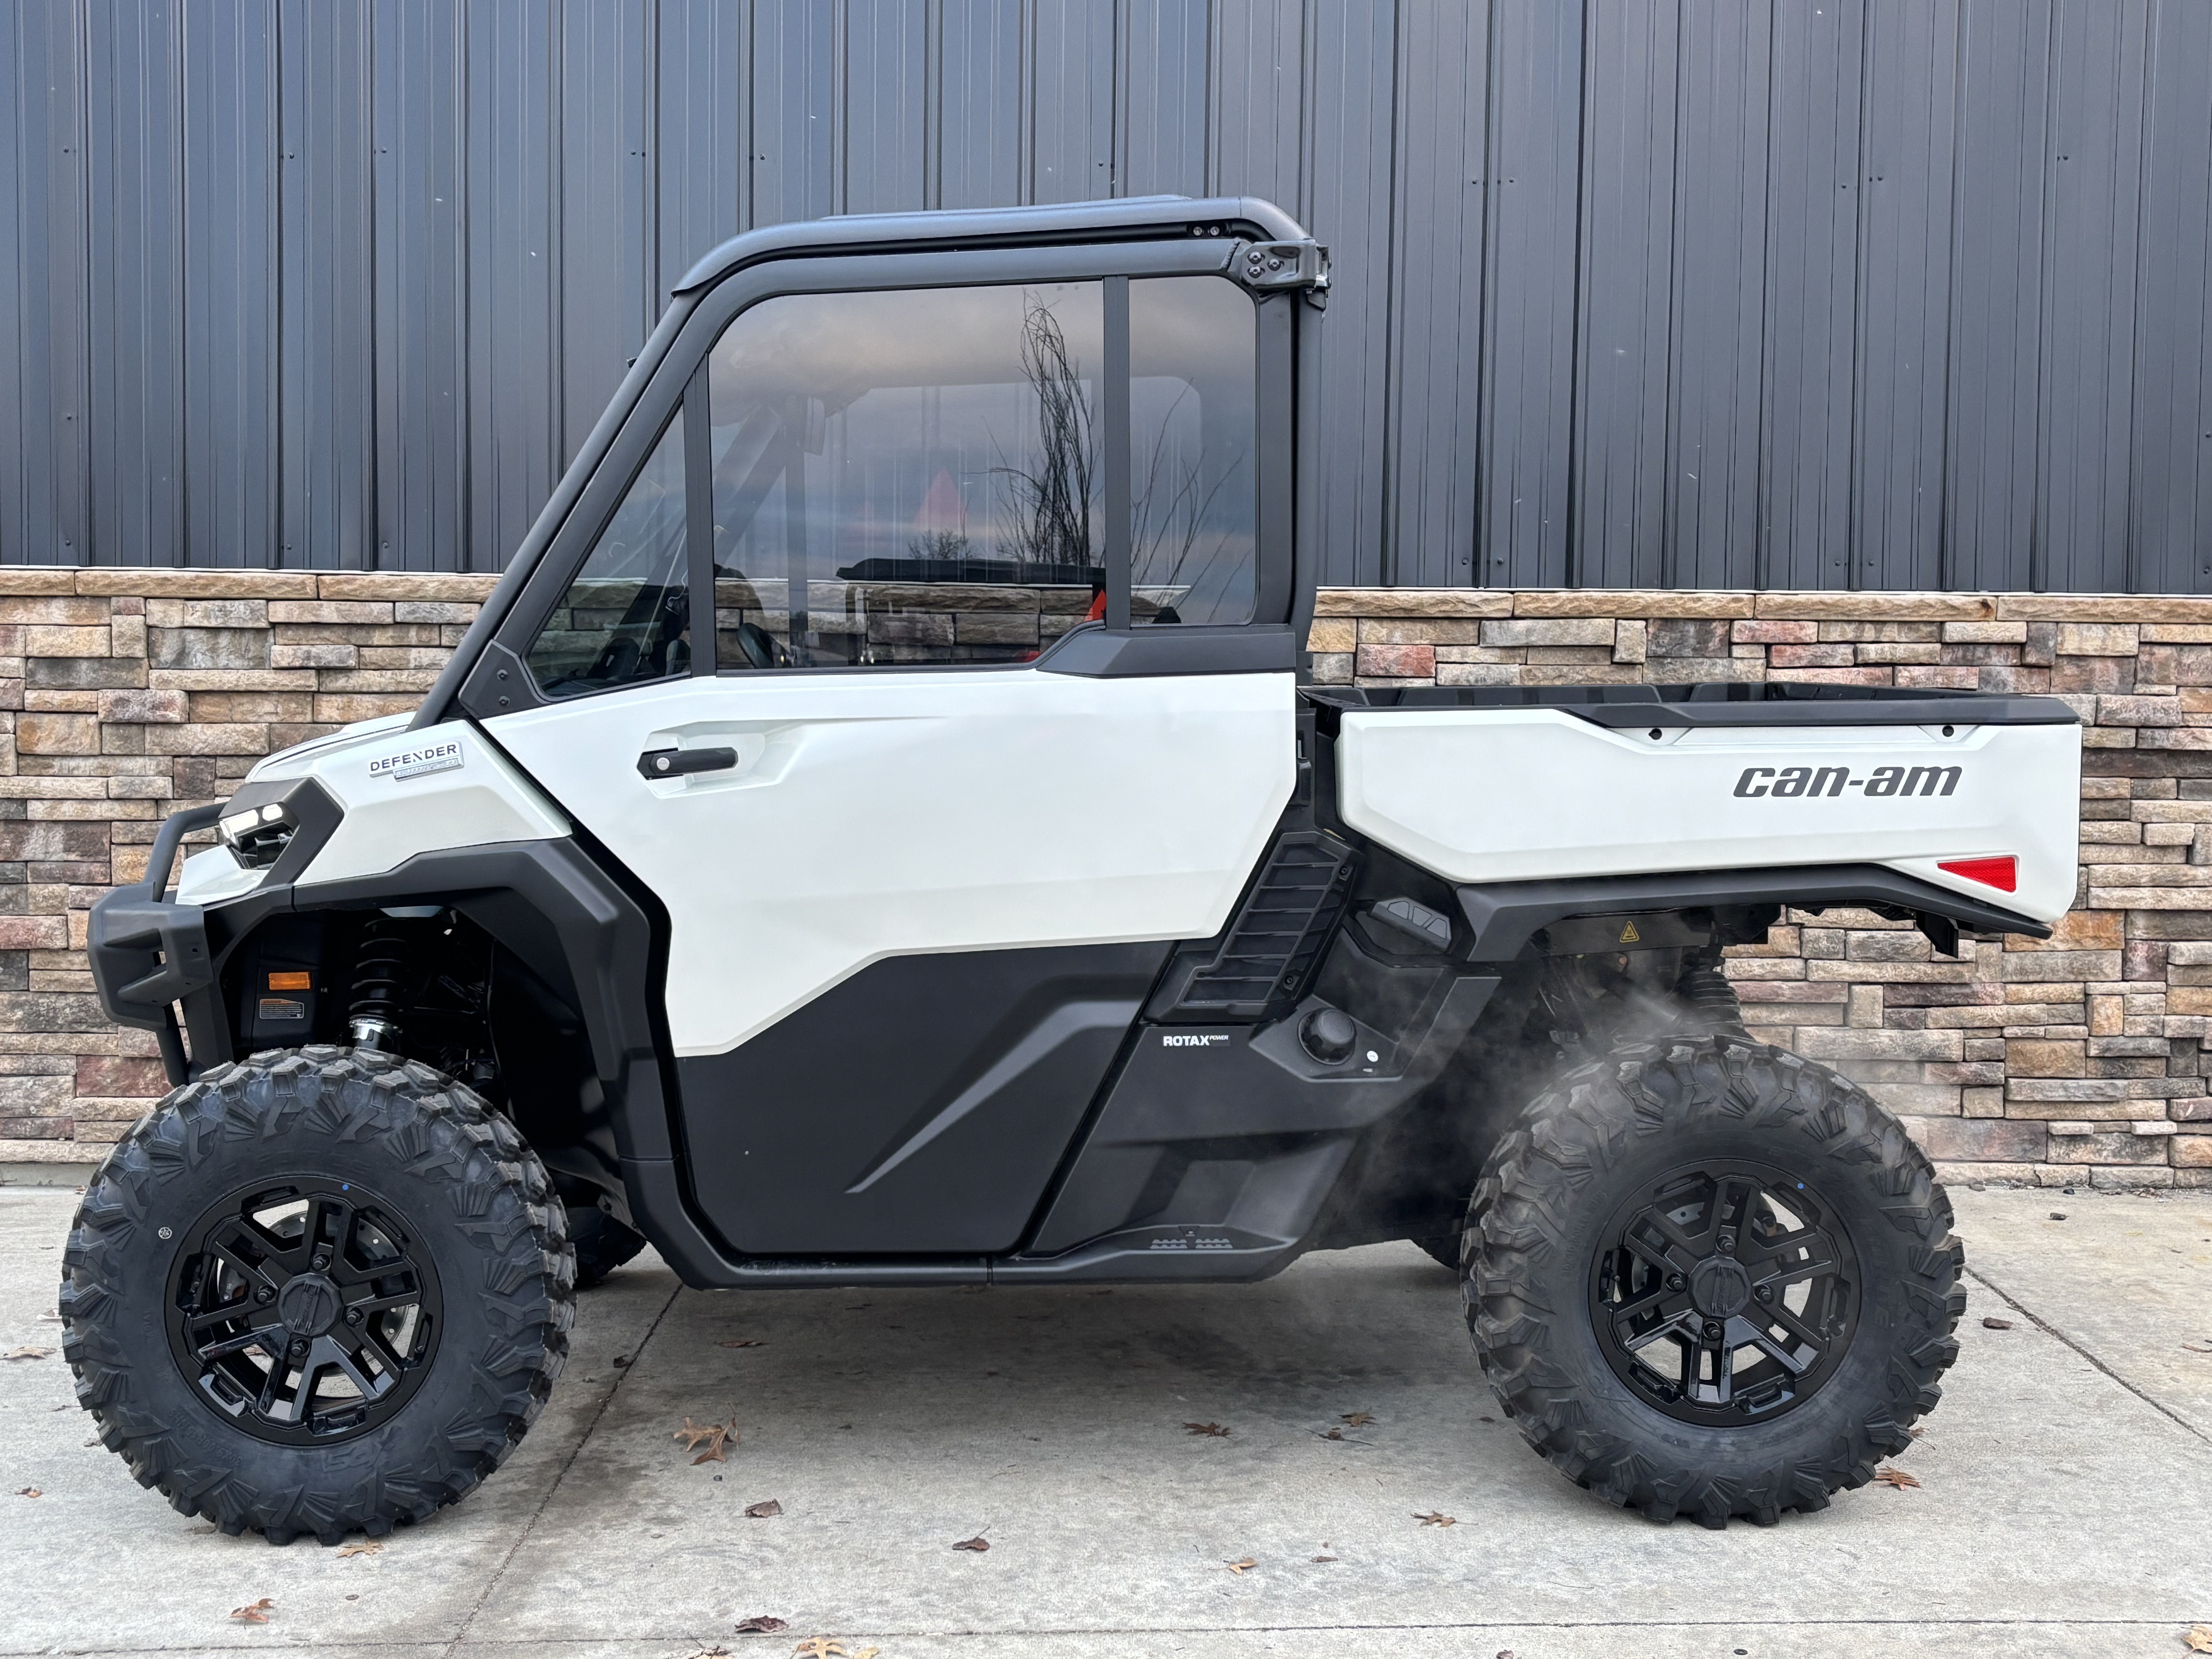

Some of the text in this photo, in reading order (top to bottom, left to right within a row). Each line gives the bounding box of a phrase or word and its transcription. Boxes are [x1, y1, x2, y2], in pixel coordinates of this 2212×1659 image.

[370, 744, 457, 771] DEFENDER
[1733, 766, 1963, 797] can-am
[1163, 1035, 1209, 1046] ROTAX
